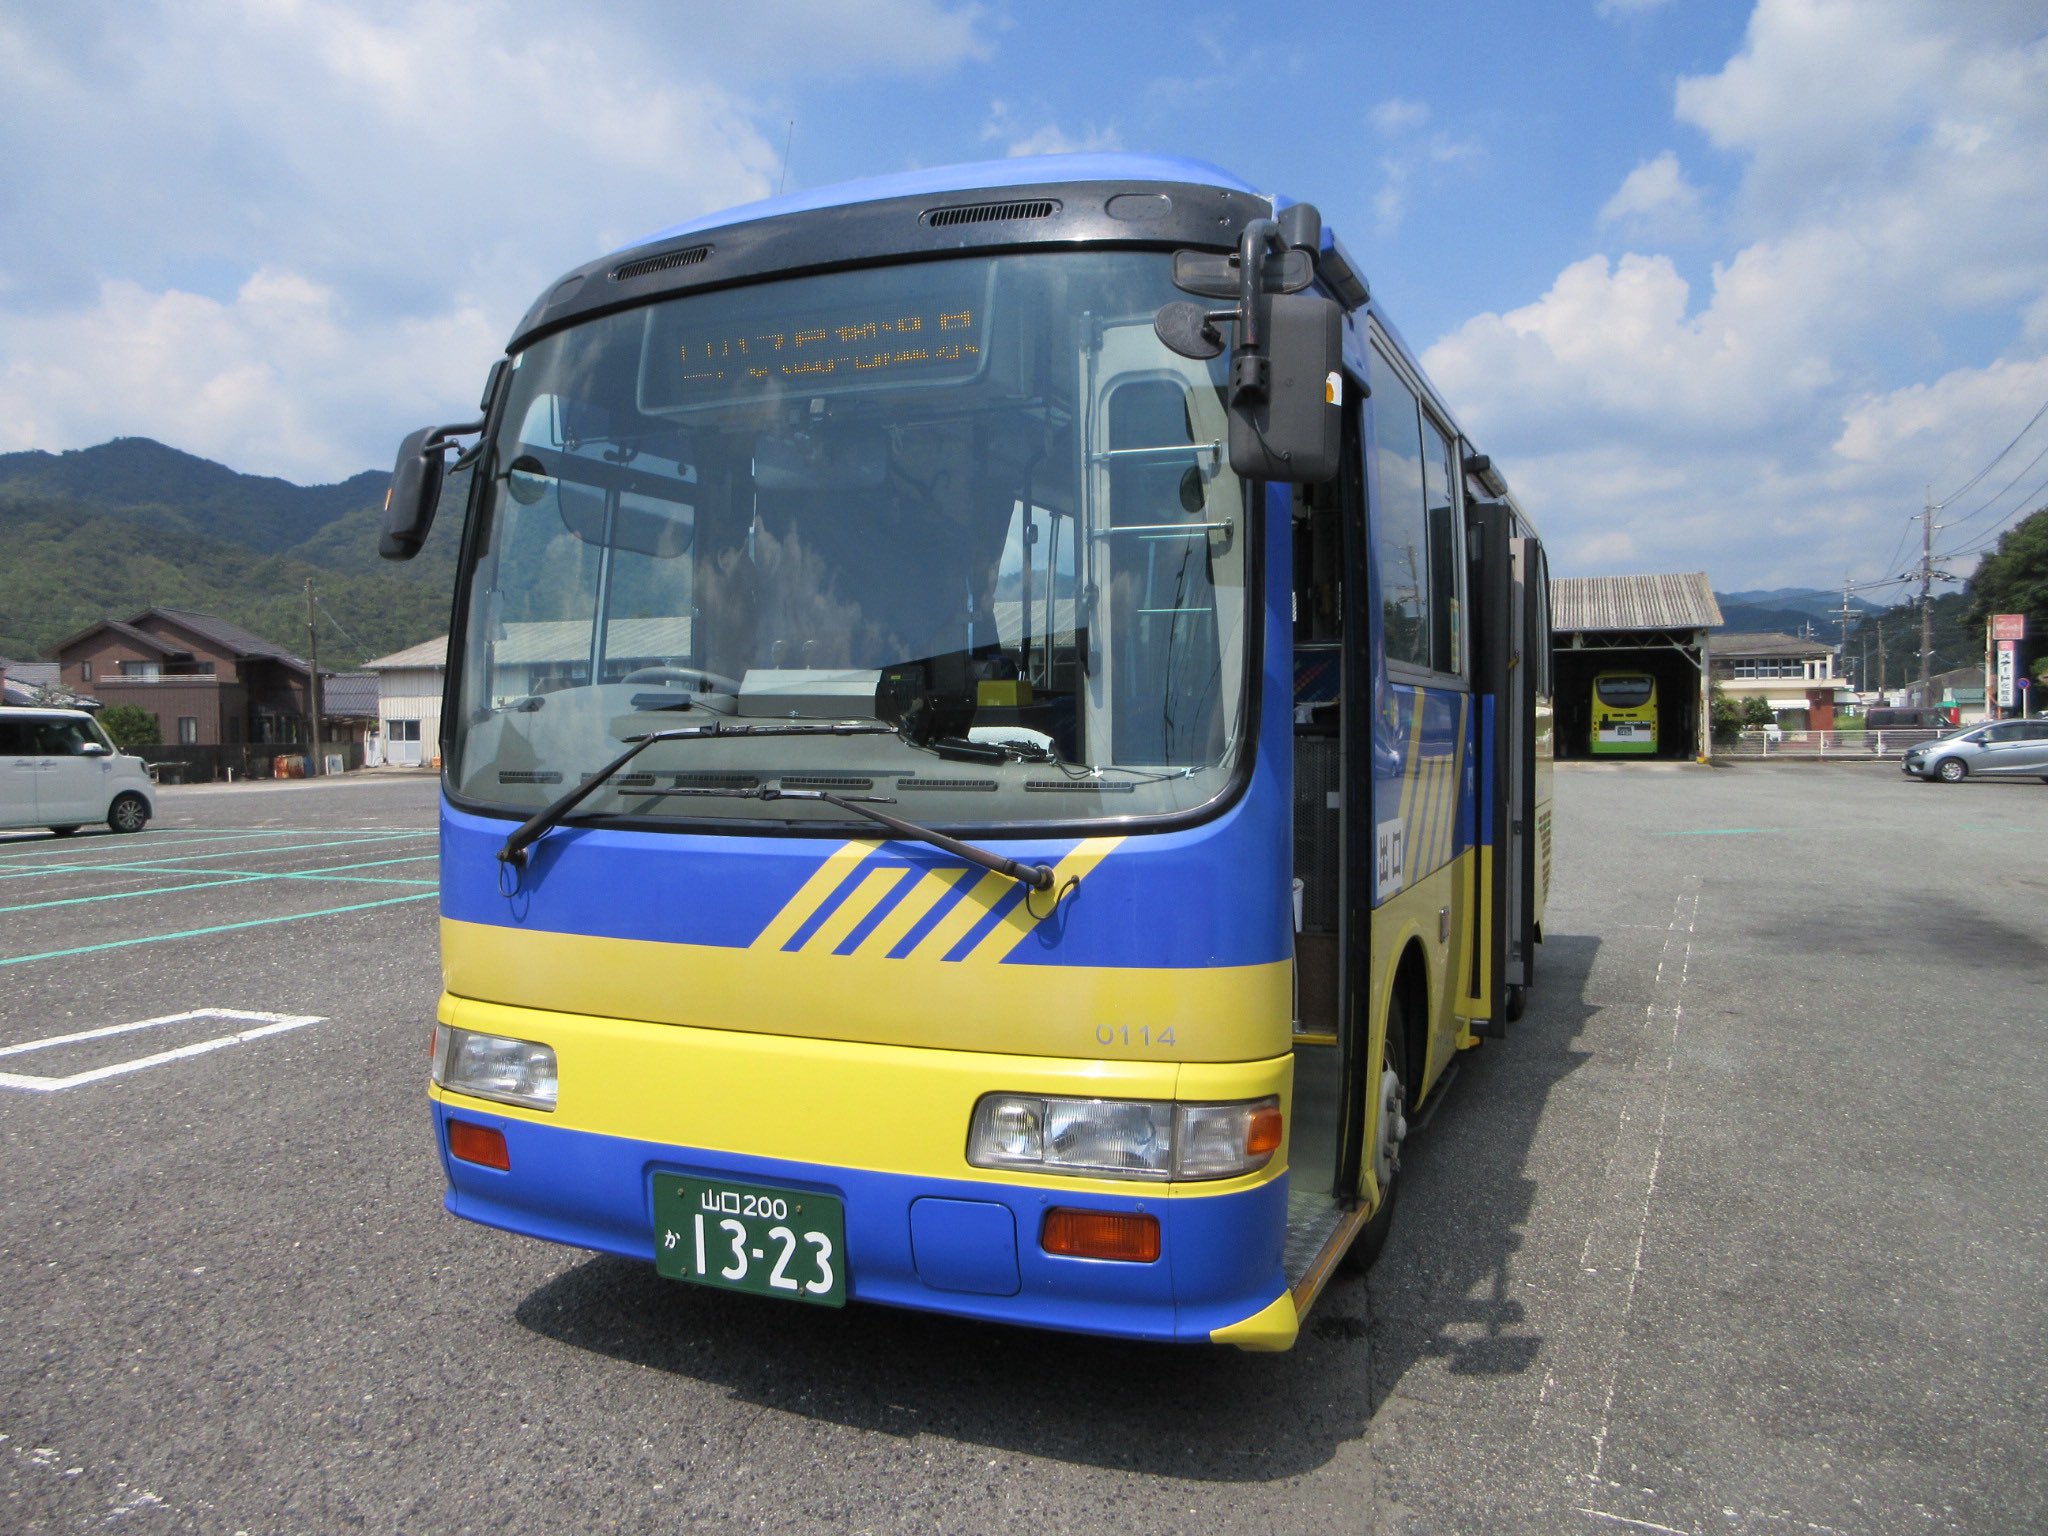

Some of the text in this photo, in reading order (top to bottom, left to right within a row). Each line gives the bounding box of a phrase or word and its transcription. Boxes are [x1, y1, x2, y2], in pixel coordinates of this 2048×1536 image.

[1379, 829, 1401, 886] 出口
[1095, 1023, 1176, 1046] 0114
[664, 1213, 834, 1294] か 13-23
